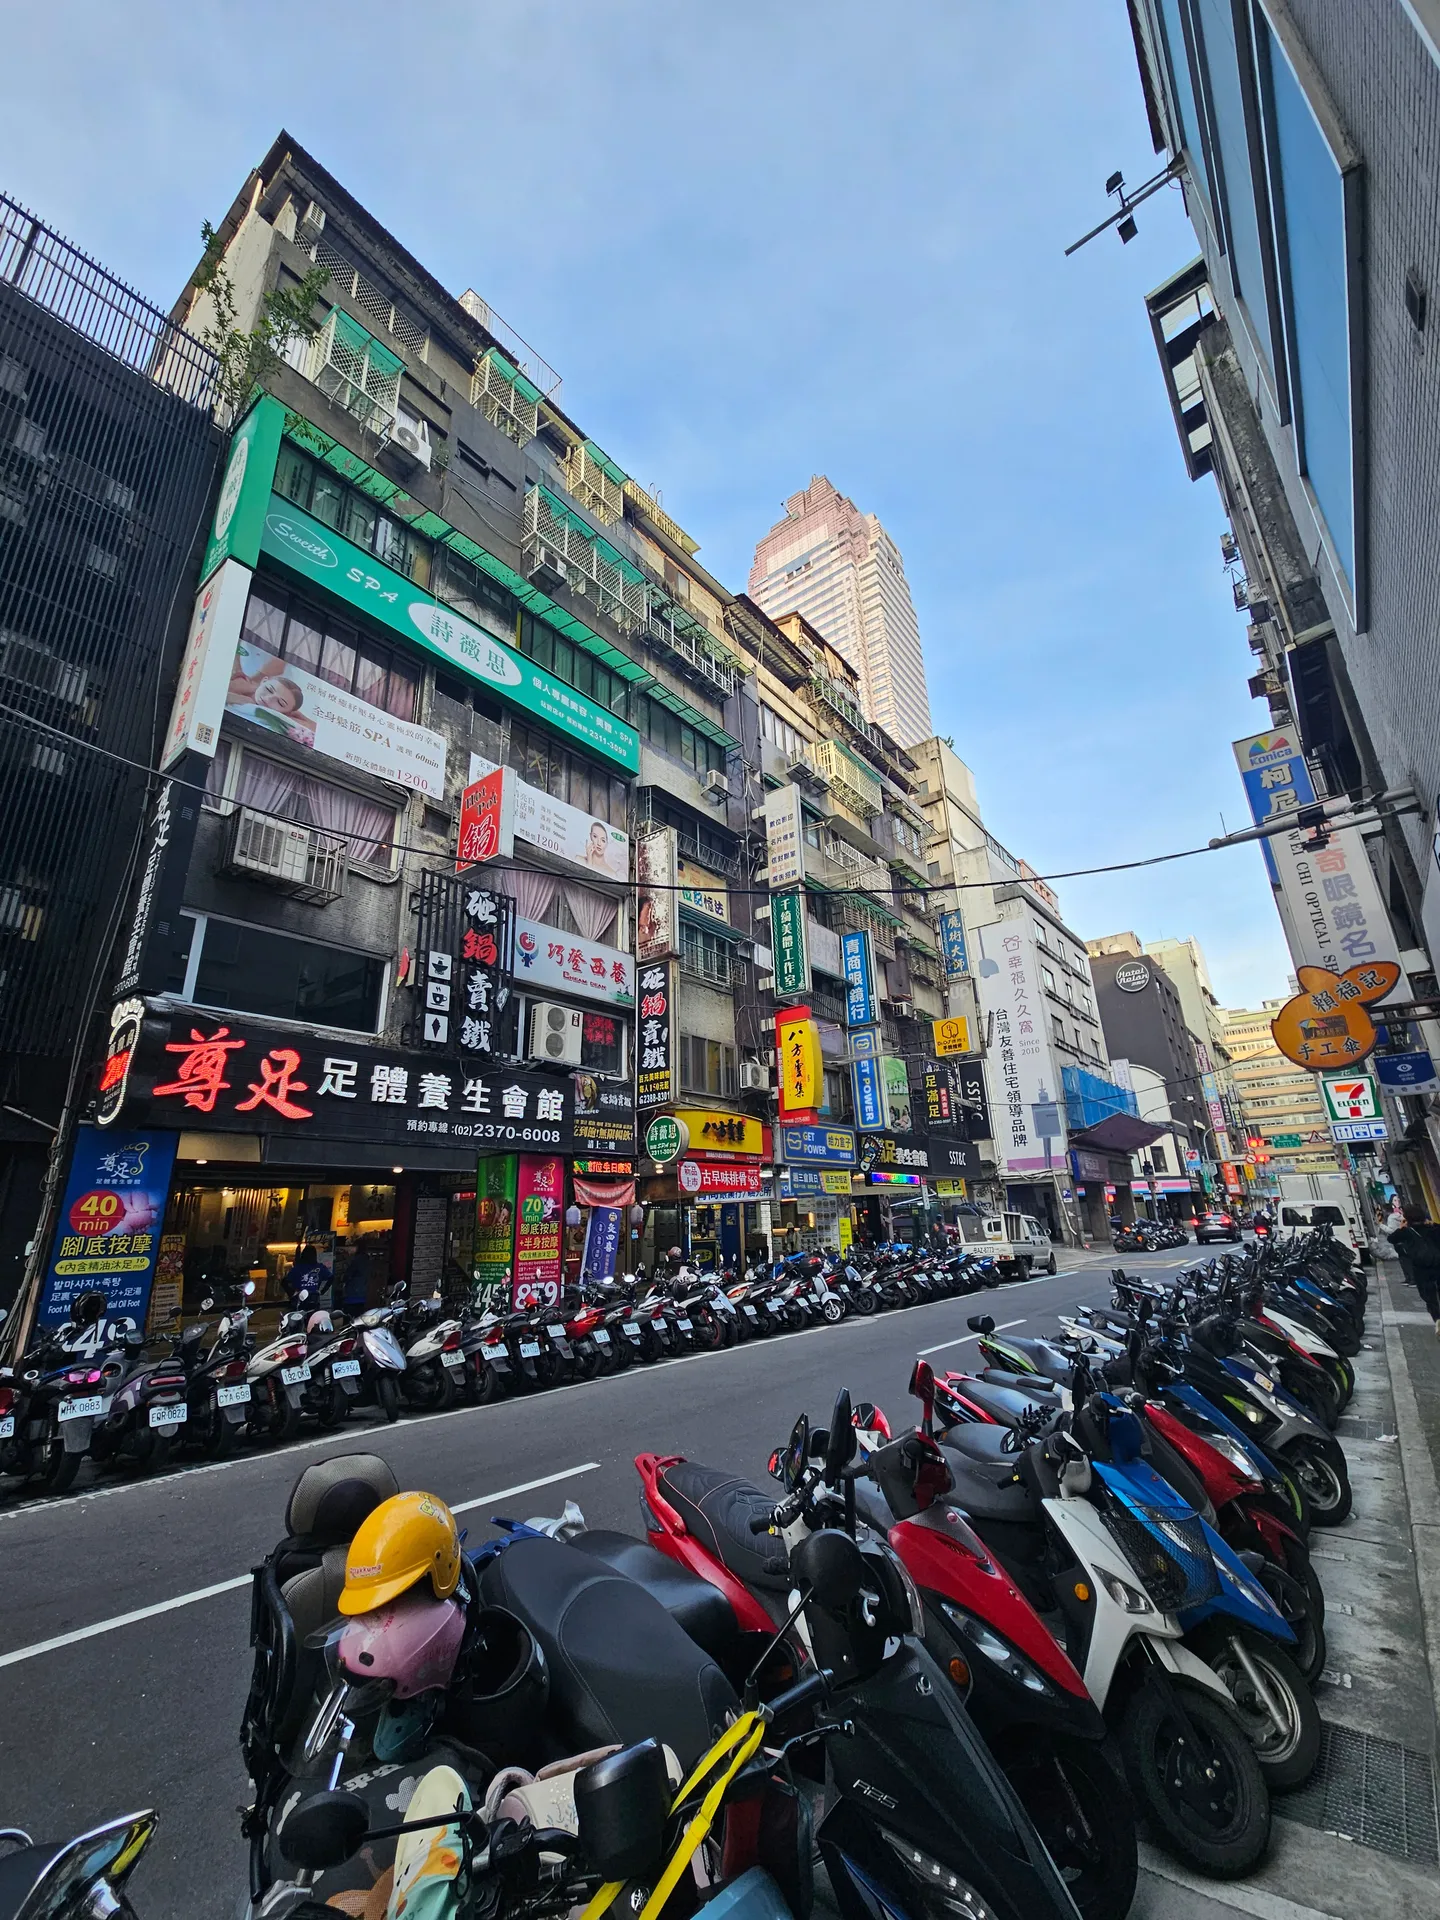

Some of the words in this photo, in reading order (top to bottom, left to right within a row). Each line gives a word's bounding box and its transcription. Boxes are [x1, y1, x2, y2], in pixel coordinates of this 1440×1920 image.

[274, 522, 328, 560] Sweith
[346, 567, 399, 603] SPA
[430, 614, 506, 677] 詩薇思
[589, 729, 627, 757] 2311-3099
[415, 752, 439, 769] 60min
[1250, 747, 1293, 767] Konica
[465, 785, 487, 811] Hot
[476, 790, 498, 817] Pot
[462, 813, 497, 867] 鍋
[1287, 830, 1305, 857] WEI
[1296, 862, 1314, 886] CHI
[1304, 891, 1332, 949] OPTICAL
[948, 915, 965, 971] 魔術大師
[460, 890, 497, 1052] 砸鍋賣鐵
[547, 942, 627, 985] 巧登西餐
[1118, 967, 1145, 979] Hotel
[845, 939, 866, 1020] 青商眼鏡行
[1119, 974, 1148, 984] Relax
[1311, 969, 1387, 1013] 賴福記
[1008, 955, 1034, 1034] 幸福久久窩
[641, 968, 667, 1068] 砸鍋賣鐵
[1018, 1037, 1040, 1048] Since
[1020, 1046, 1040, 1056] 2010
[1297, 1037, 1361, 1061] 手工傘
[153, 1027, 314, 1119] 尊足
[788, 1029, 805, 1098] 八方雲集
[316, 1057, 565, 1122] 足體養生會館
[995, 1008, 1029, 1148] 台灣友善住宅領導品牌
[862, 1076, 875, 1122] POWER
[925, 1074, 941, 1118] 足滿足
[1334, 1083, 1366, 1117] 7
[1337, 1098, 1370, 1108] ELEVEN
[406, 1119, 449, 1134] 預約專線
[650, 1124, 677, 1141] 詩薇思
[700, 1118, 746, 1142] 八方雲集
[803, 1132, 815, 1142] GET
[803, 1144, 827, 1155] POWER
[828, 1136, 851, 1149] 給力盒子
[97, 1153, 130, 1179] 尊足
[683, 1165, 698, 1176] 新品
[702, 1168, 747, 1186] 古早味排骨
[533, 1170, 549, 1188] 尊足
[686, 1177, 698, 1188] 上市
[952, 1180, 960, 1193] P
[79, 1195, 118, 1216] 40
[525, 1198, 542, 1213] 70
[78, 1218, 110, 1231] min
[520, 1222, 559, 1236] 腳底按摩
[525, 1214, 540, 1223] min
[59, 1233, 153, 1258] 腳底按摩
[519, 1236, 559, 1249] +半身按摩
[48, 1304, 63, 1315] Foot
[118, 1299, 126, 1309] Oil
[128, 1298, 140, 1308] Foot
